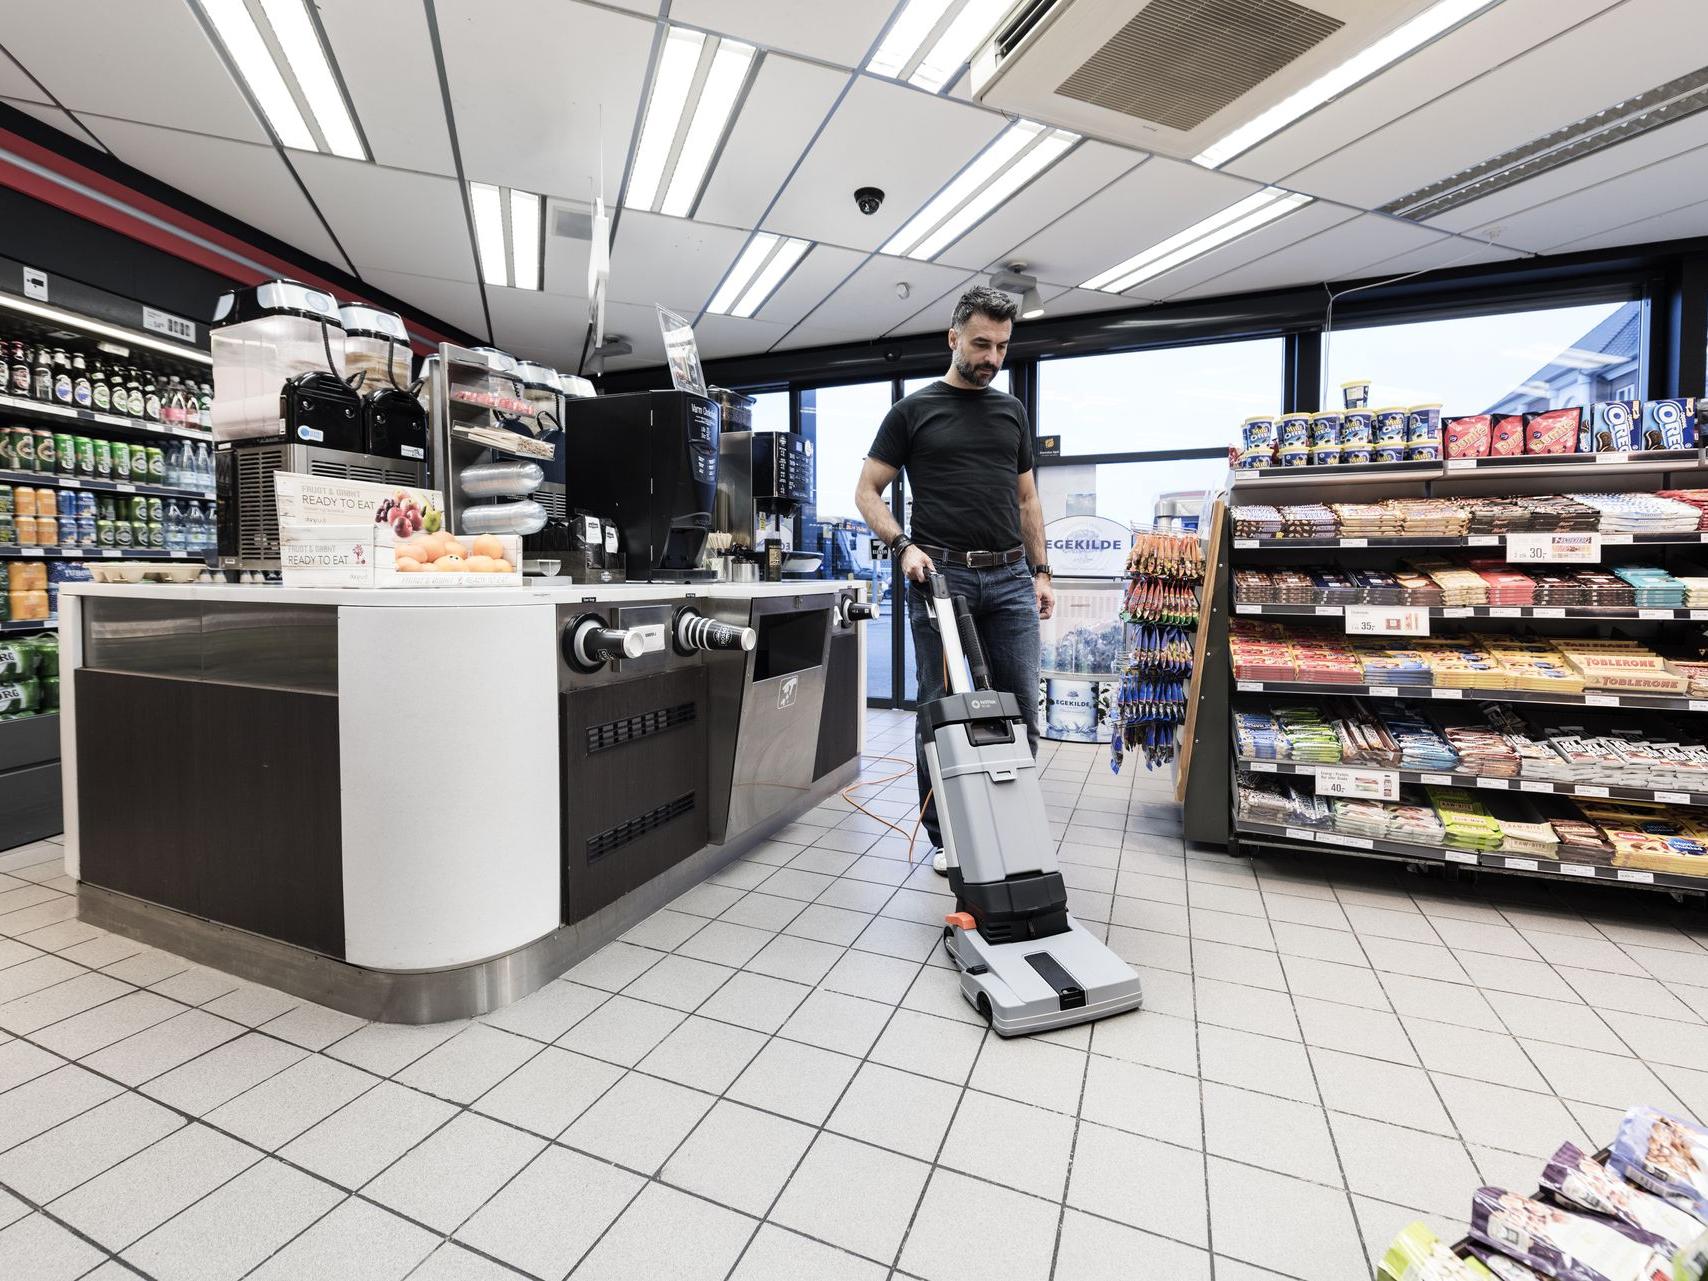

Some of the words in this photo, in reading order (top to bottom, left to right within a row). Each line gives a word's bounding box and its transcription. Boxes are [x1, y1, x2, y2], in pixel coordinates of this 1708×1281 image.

[302, 495, 337, 506] READY
[341, 499, 355, 508] TO
[358, 501, 375, 510] EAT
[1046, 540, 1122, 550] EGEKILDE
[288, 556, 316, 565] READY
[319, 556, 331, 565] TO
[333, 556, 348, 565] EAT
[1585, 656, 1656, 668] TOBLERONE
[1602, 677, 1679, 689] TOBLERONE
[1056, 699, 1090, 707] EGEKILDE
